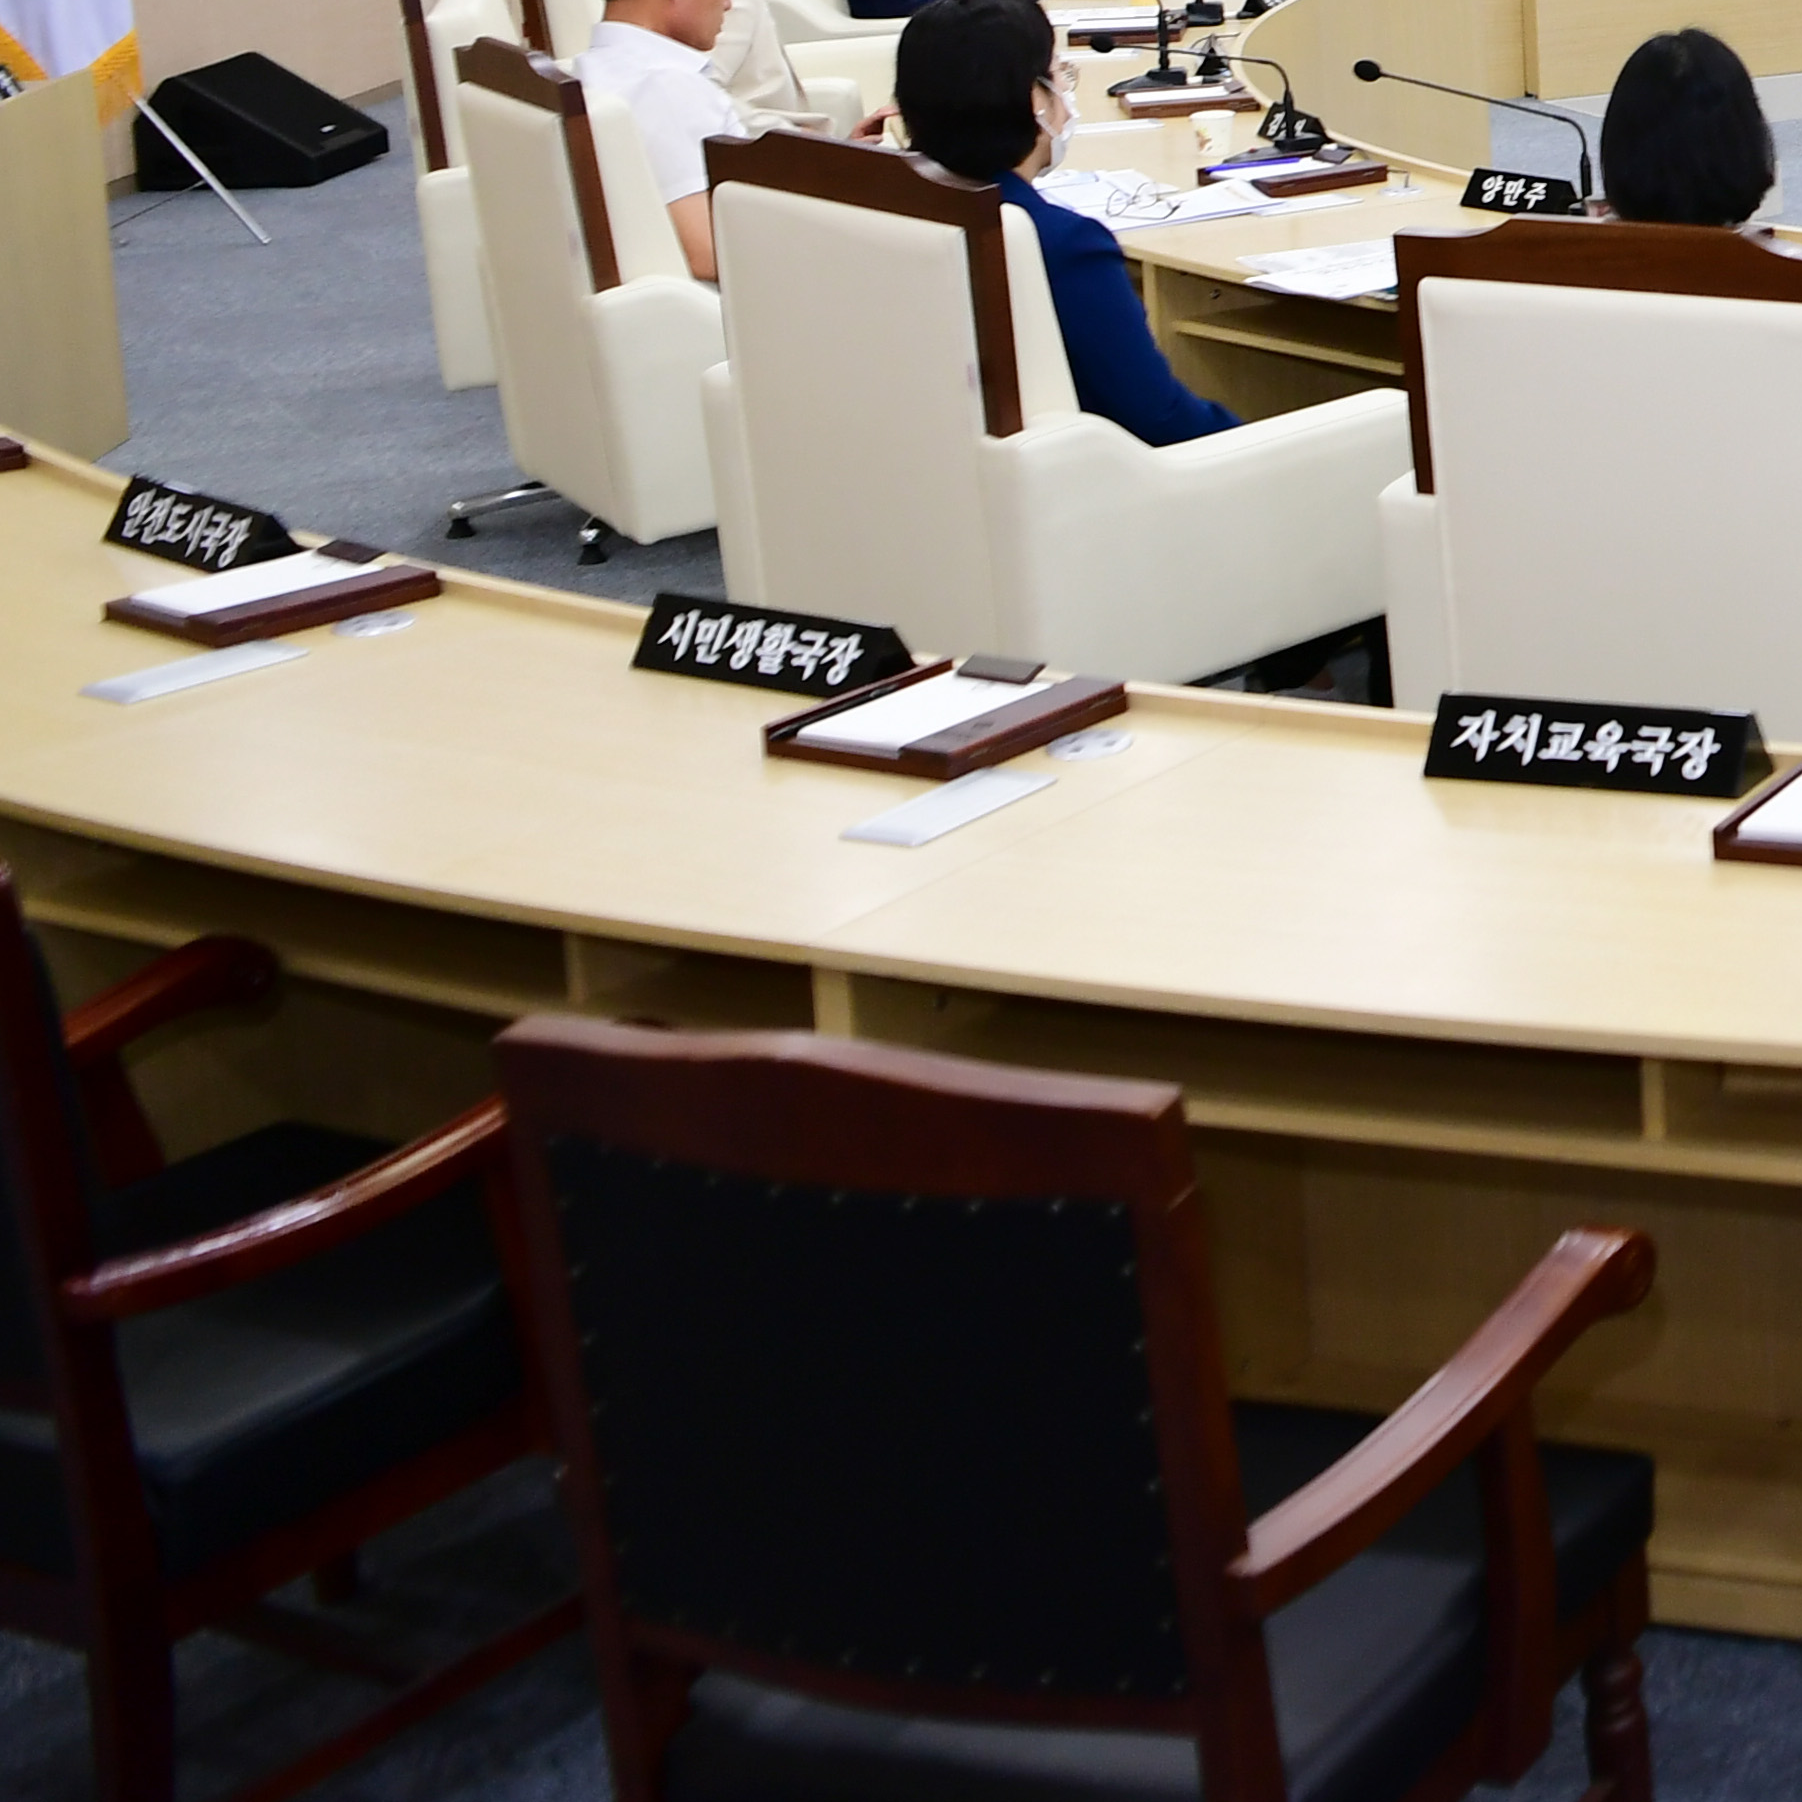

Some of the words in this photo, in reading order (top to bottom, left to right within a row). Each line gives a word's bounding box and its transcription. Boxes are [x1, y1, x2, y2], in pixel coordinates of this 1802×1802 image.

[1481, 174, 1548, 210] 양만주
[121, 488, 253, 568] 안전도시국장
[657, 609, 864, 685] 시민생활국장
[1450, 708, 1722, 781] 자치교육국장
